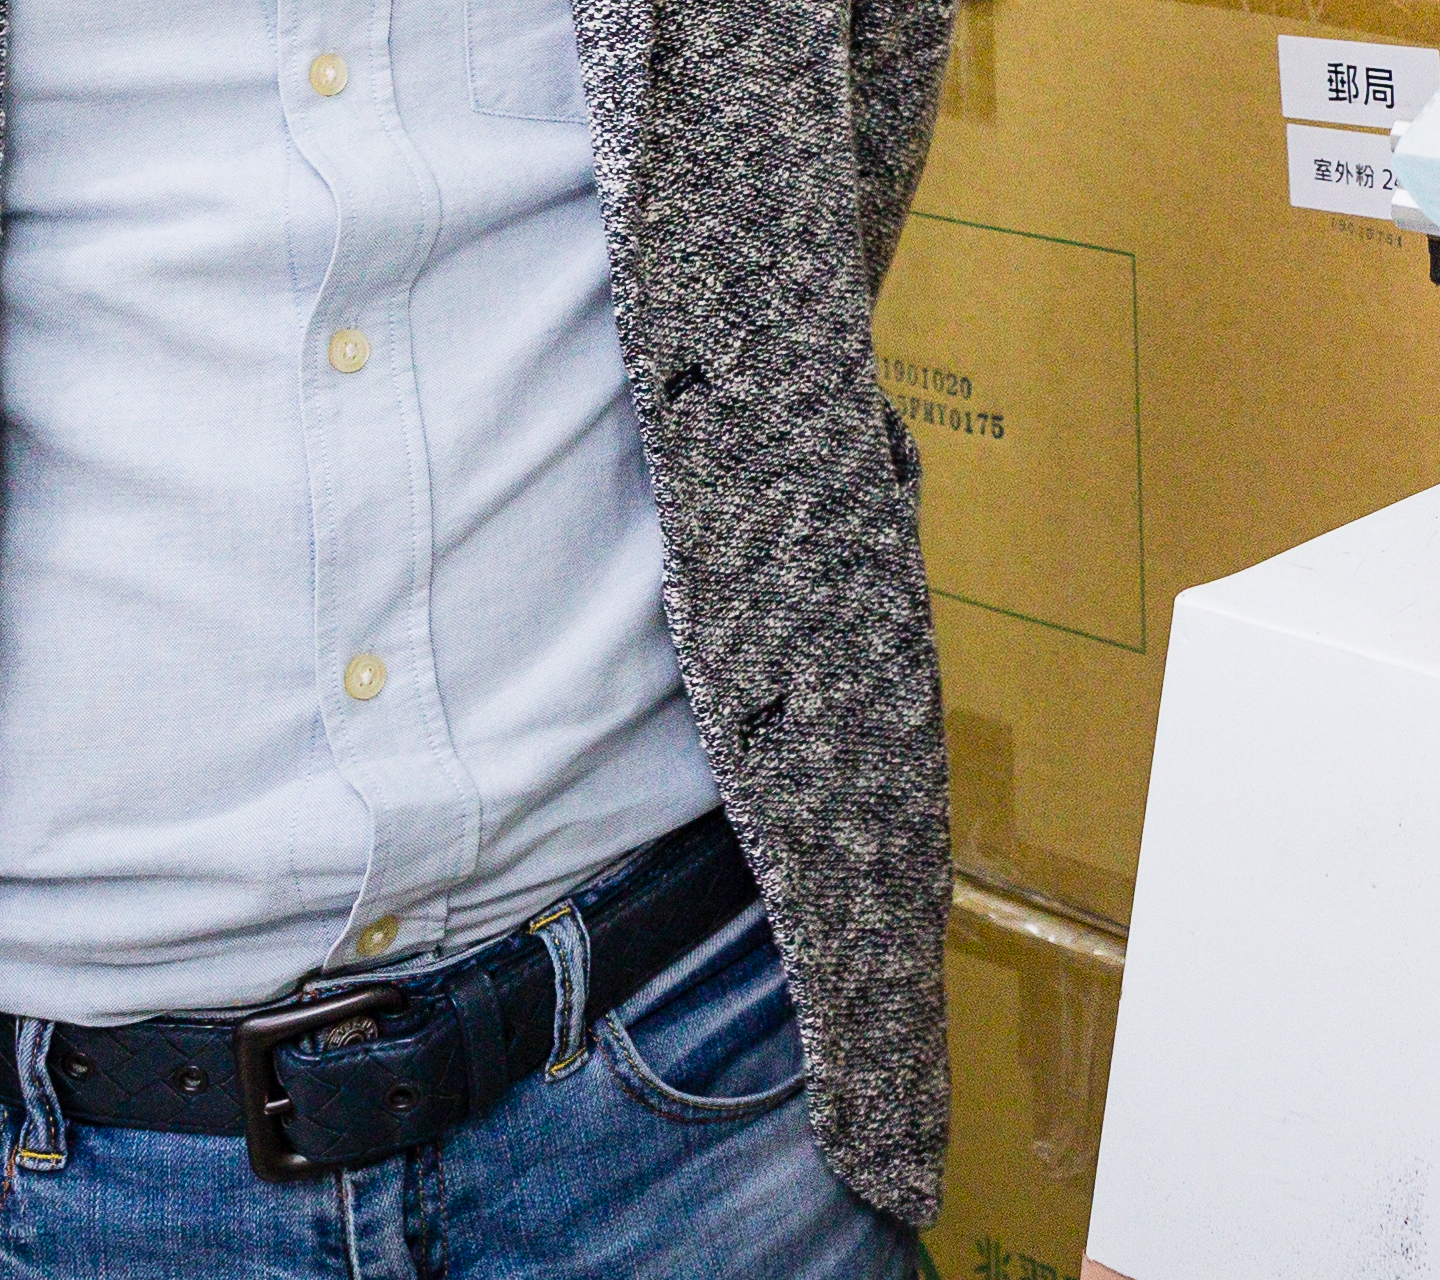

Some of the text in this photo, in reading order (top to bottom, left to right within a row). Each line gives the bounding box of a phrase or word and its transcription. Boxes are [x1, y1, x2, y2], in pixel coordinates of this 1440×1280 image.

[1327, 62, 1395, 109] 郵局
[1314, 158, 1400, 191] 室外粉 2
